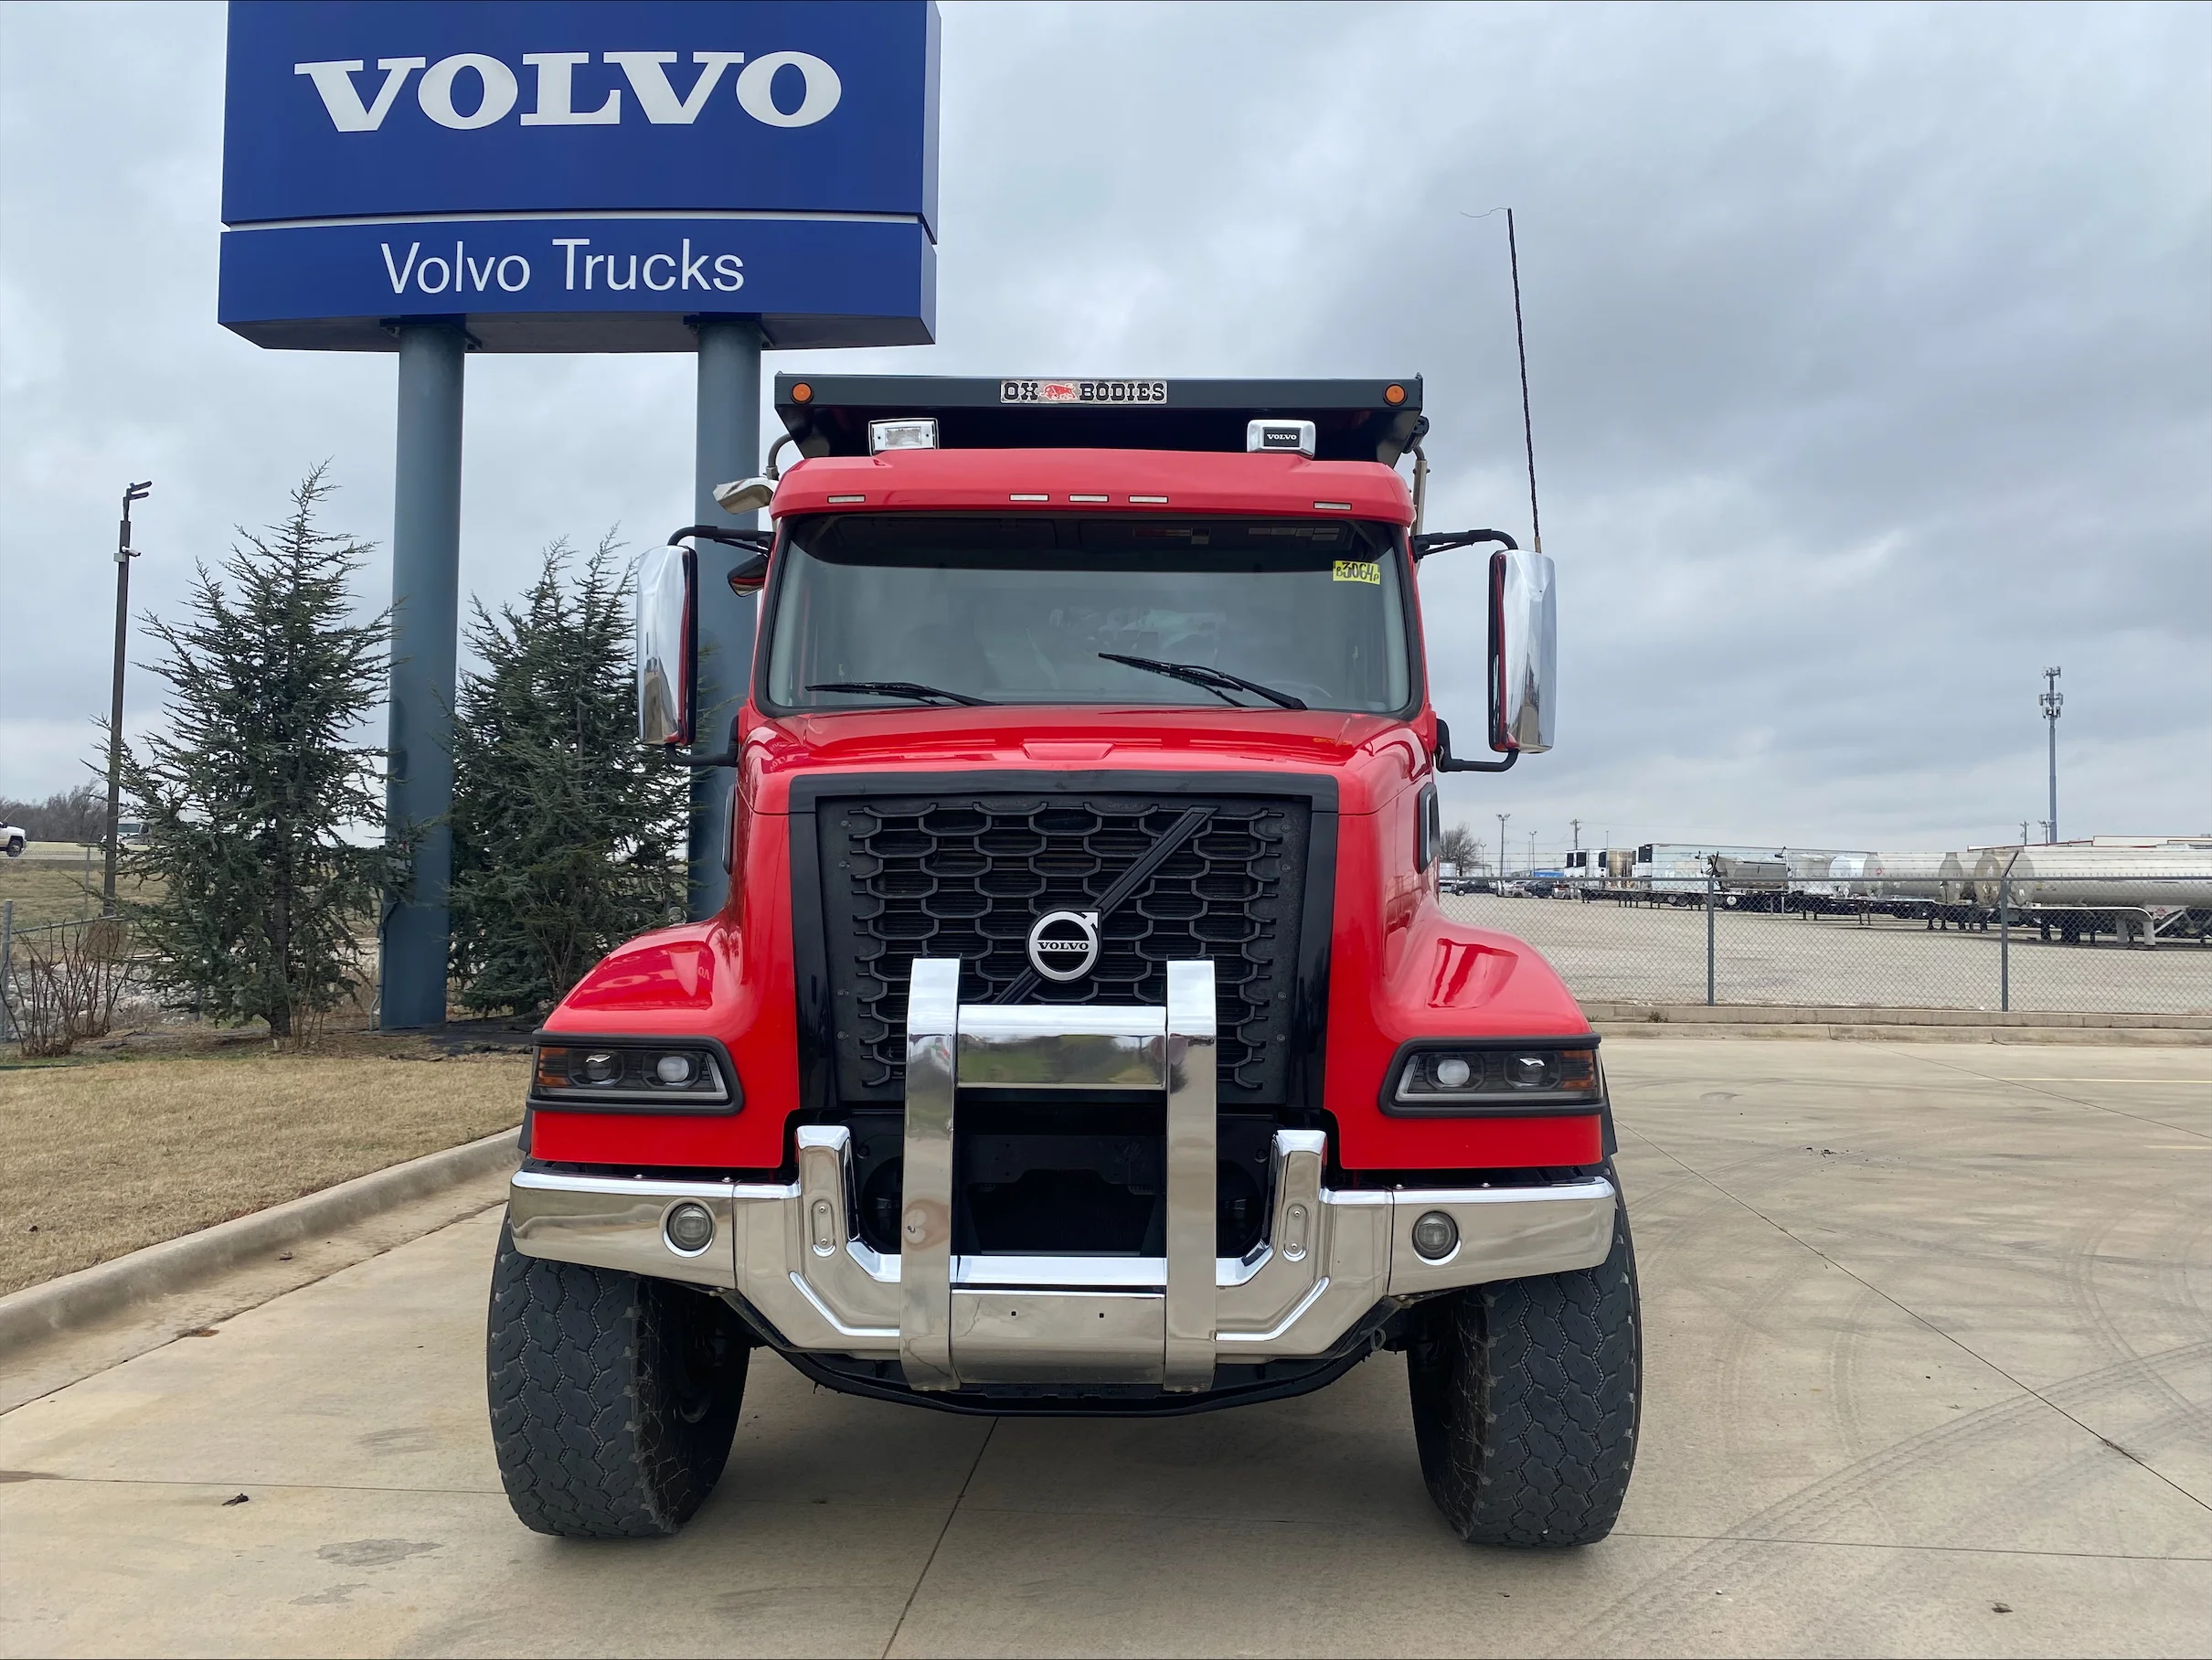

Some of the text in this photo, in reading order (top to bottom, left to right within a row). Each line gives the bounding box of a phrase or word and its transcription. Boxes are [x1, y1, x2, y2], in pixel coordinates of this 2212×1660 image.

[294, 51, 841, 132] VOLVO
[380, 239, 744, 293] Volvo Trucks
[1004, 382, 1164, 401] OX BODIES
